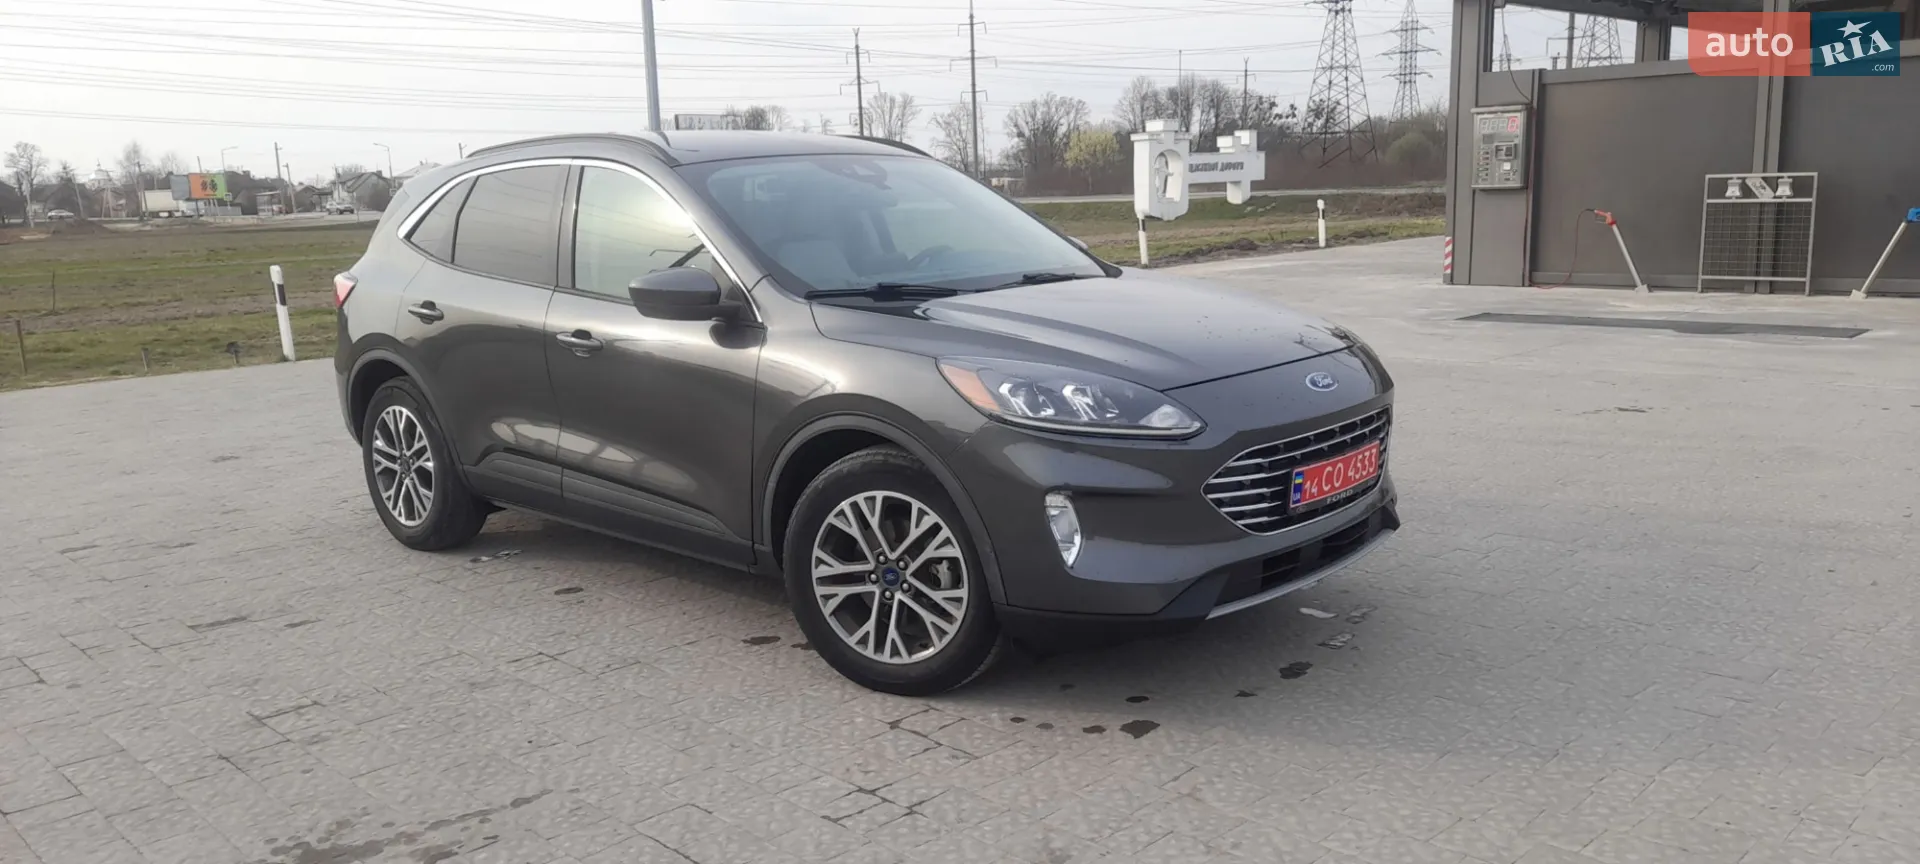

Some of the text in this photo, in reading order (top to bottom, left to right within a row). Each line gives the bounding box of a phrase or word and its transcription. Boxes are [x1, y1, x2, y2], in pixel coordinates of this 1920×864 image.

[1314, 375, 1333, 386] Ford
[1304, 448, 1377, 499] 14 CO 4533
[1292, 493, 1301, 502] UA
[1326, 489, 1354, 504] FORD
